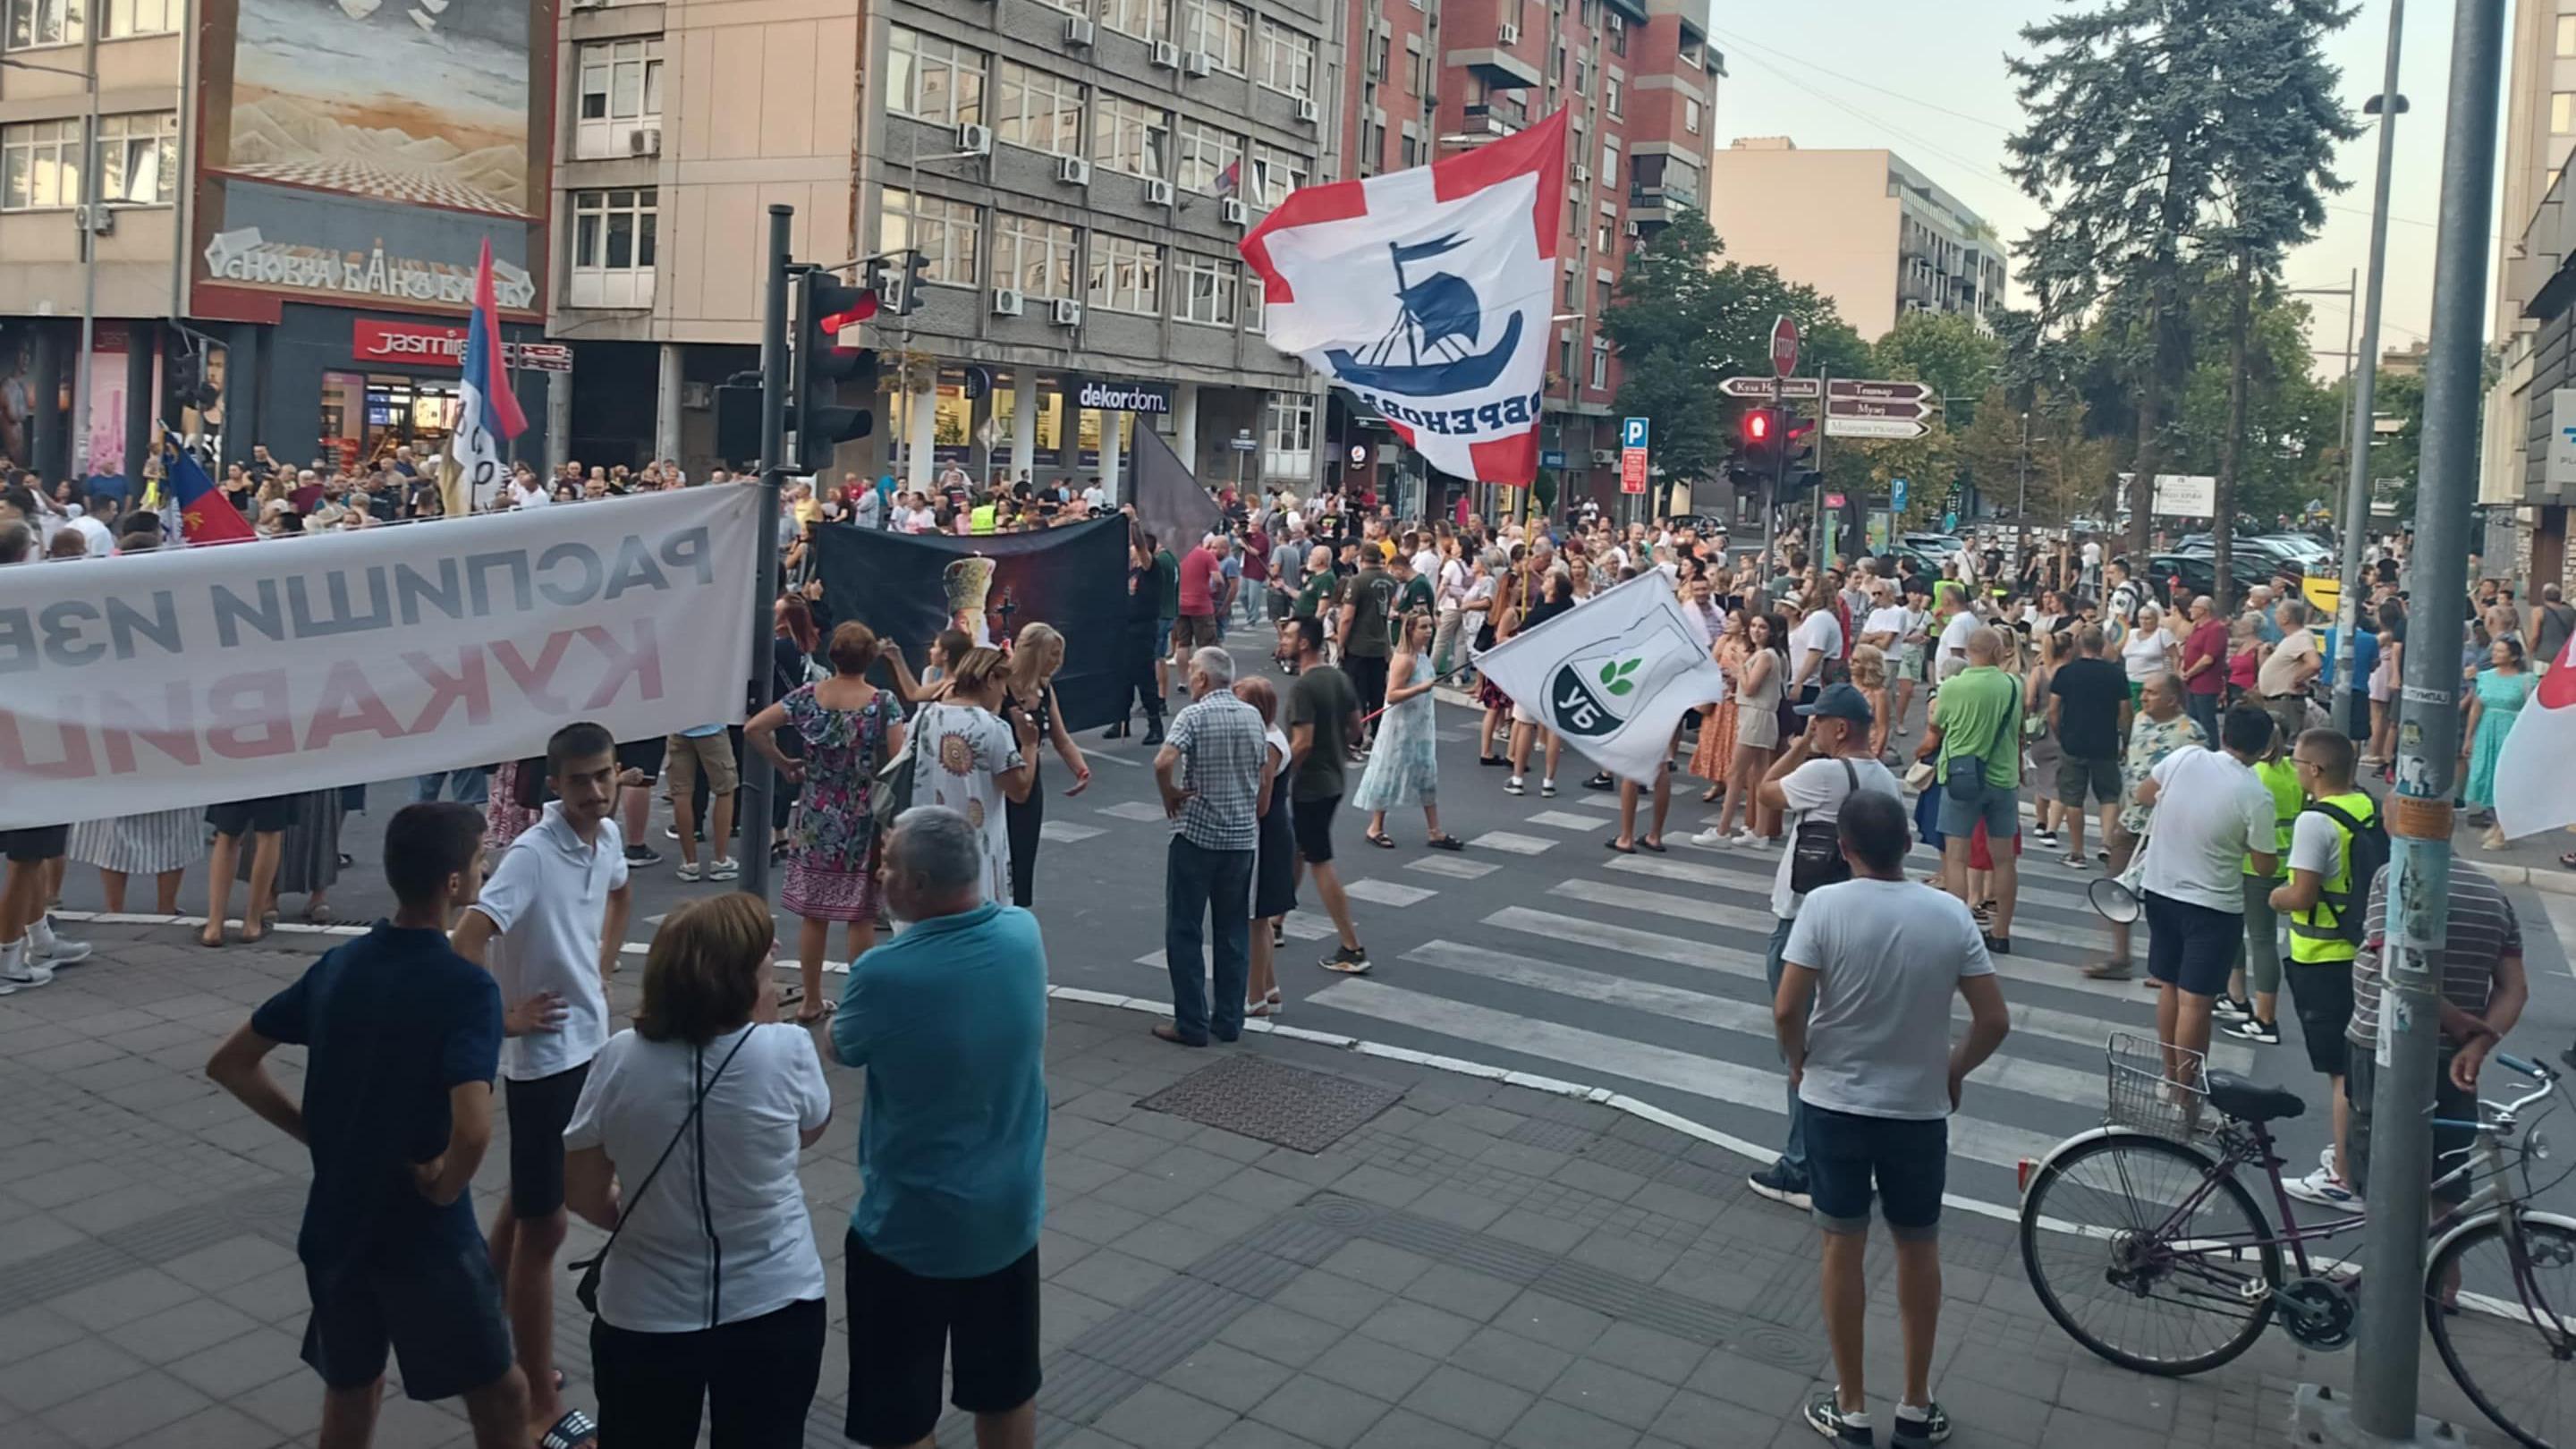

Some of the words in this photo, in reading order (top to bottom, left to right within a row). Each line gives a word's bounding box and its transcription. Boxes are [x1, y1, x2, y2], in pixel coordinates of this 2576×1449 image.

[1775, 336, 1796, 359] STOP
[1628, 421, 1643, 445] P
[1895, 480, 1904, 498] P
[1558, 685, 1603, 729] УБ
